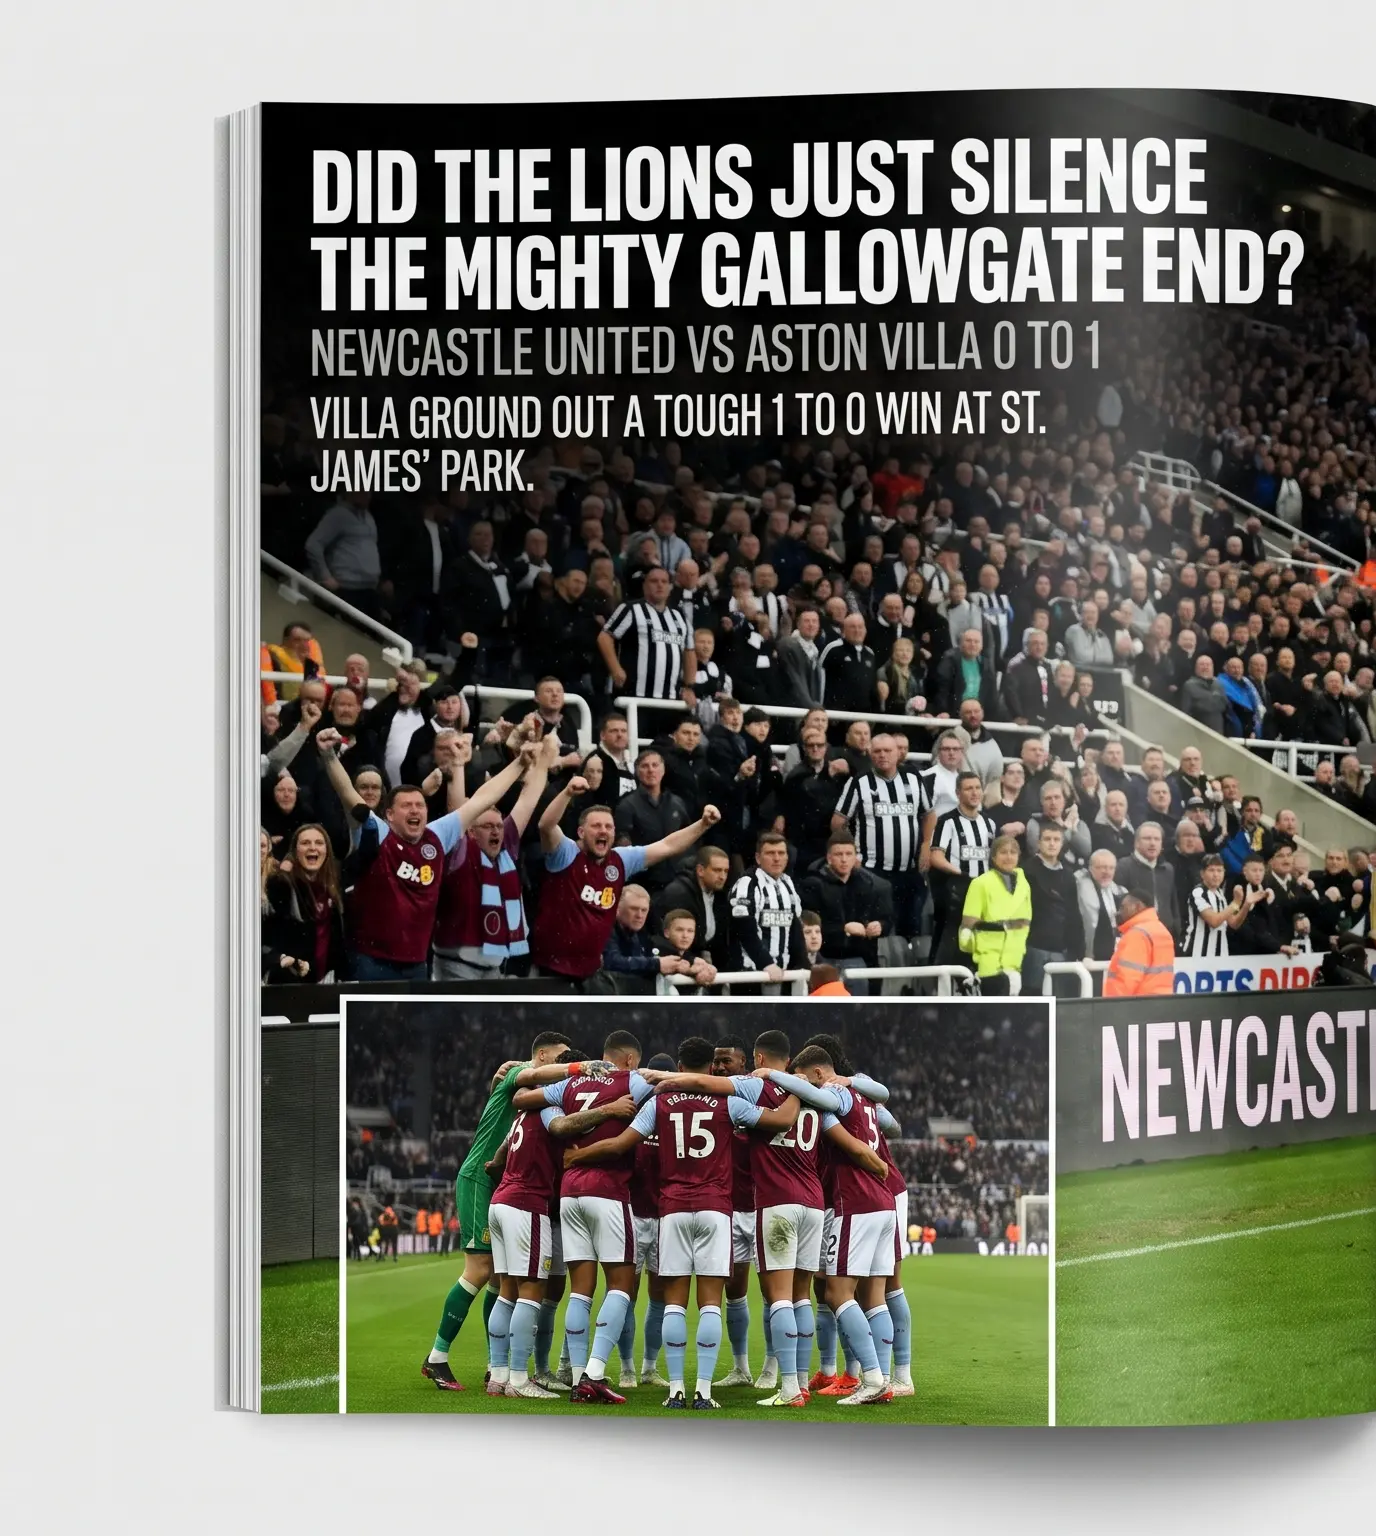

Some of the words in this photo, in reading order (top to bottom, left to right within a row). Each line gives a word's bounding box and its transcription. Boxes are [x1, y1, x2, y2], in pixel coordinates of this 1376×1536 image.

[314, 150, 416, 223] DID
[435, 149, 551, 223] THE
[571, 144, 752, 221] LIONS
[771, 140, 933, 217] JUST
[951, 138, 1207, 214] SILENCE
[311, 238, 427, 310] THE
[446, 234, 683, 310] MIGHTY
[702, 227, 1124, 307] GALLOWGATE
[1143, 227, 1304, 305] END?
[312, 328, 532, 376] NEWCASTLE
[546, 327, 674, 375] UNITED
[687, 325, 734, 372] VS
[746, 323, 866, 372] ASTON
[879, 322, 982, 370] VILLA
[994, 321, 1015, 369] 0
[1027, 320, 1073, 369] TO
[1086, 320, 1099, 369] 1
[311, 397, 399, 438] VILLA
[410, 396, 541, 438] GROUND
[553, 396, 614, 438] OUT
[624, 395, 644, 436] A
[654, 394, 760, 436] TOUGH
[773, 394, 782, 435] 1
[795, 393, 834, 435] TO
[847, 392, 865, 435] 0
[876, 392, 941, 434] WIN
[952, 391, 991, 433] AT
[1002, 391, 1045, 433] ST.
[442, 450, 533, 491] PARK.
[669, 1111, 716, 1159] 15
